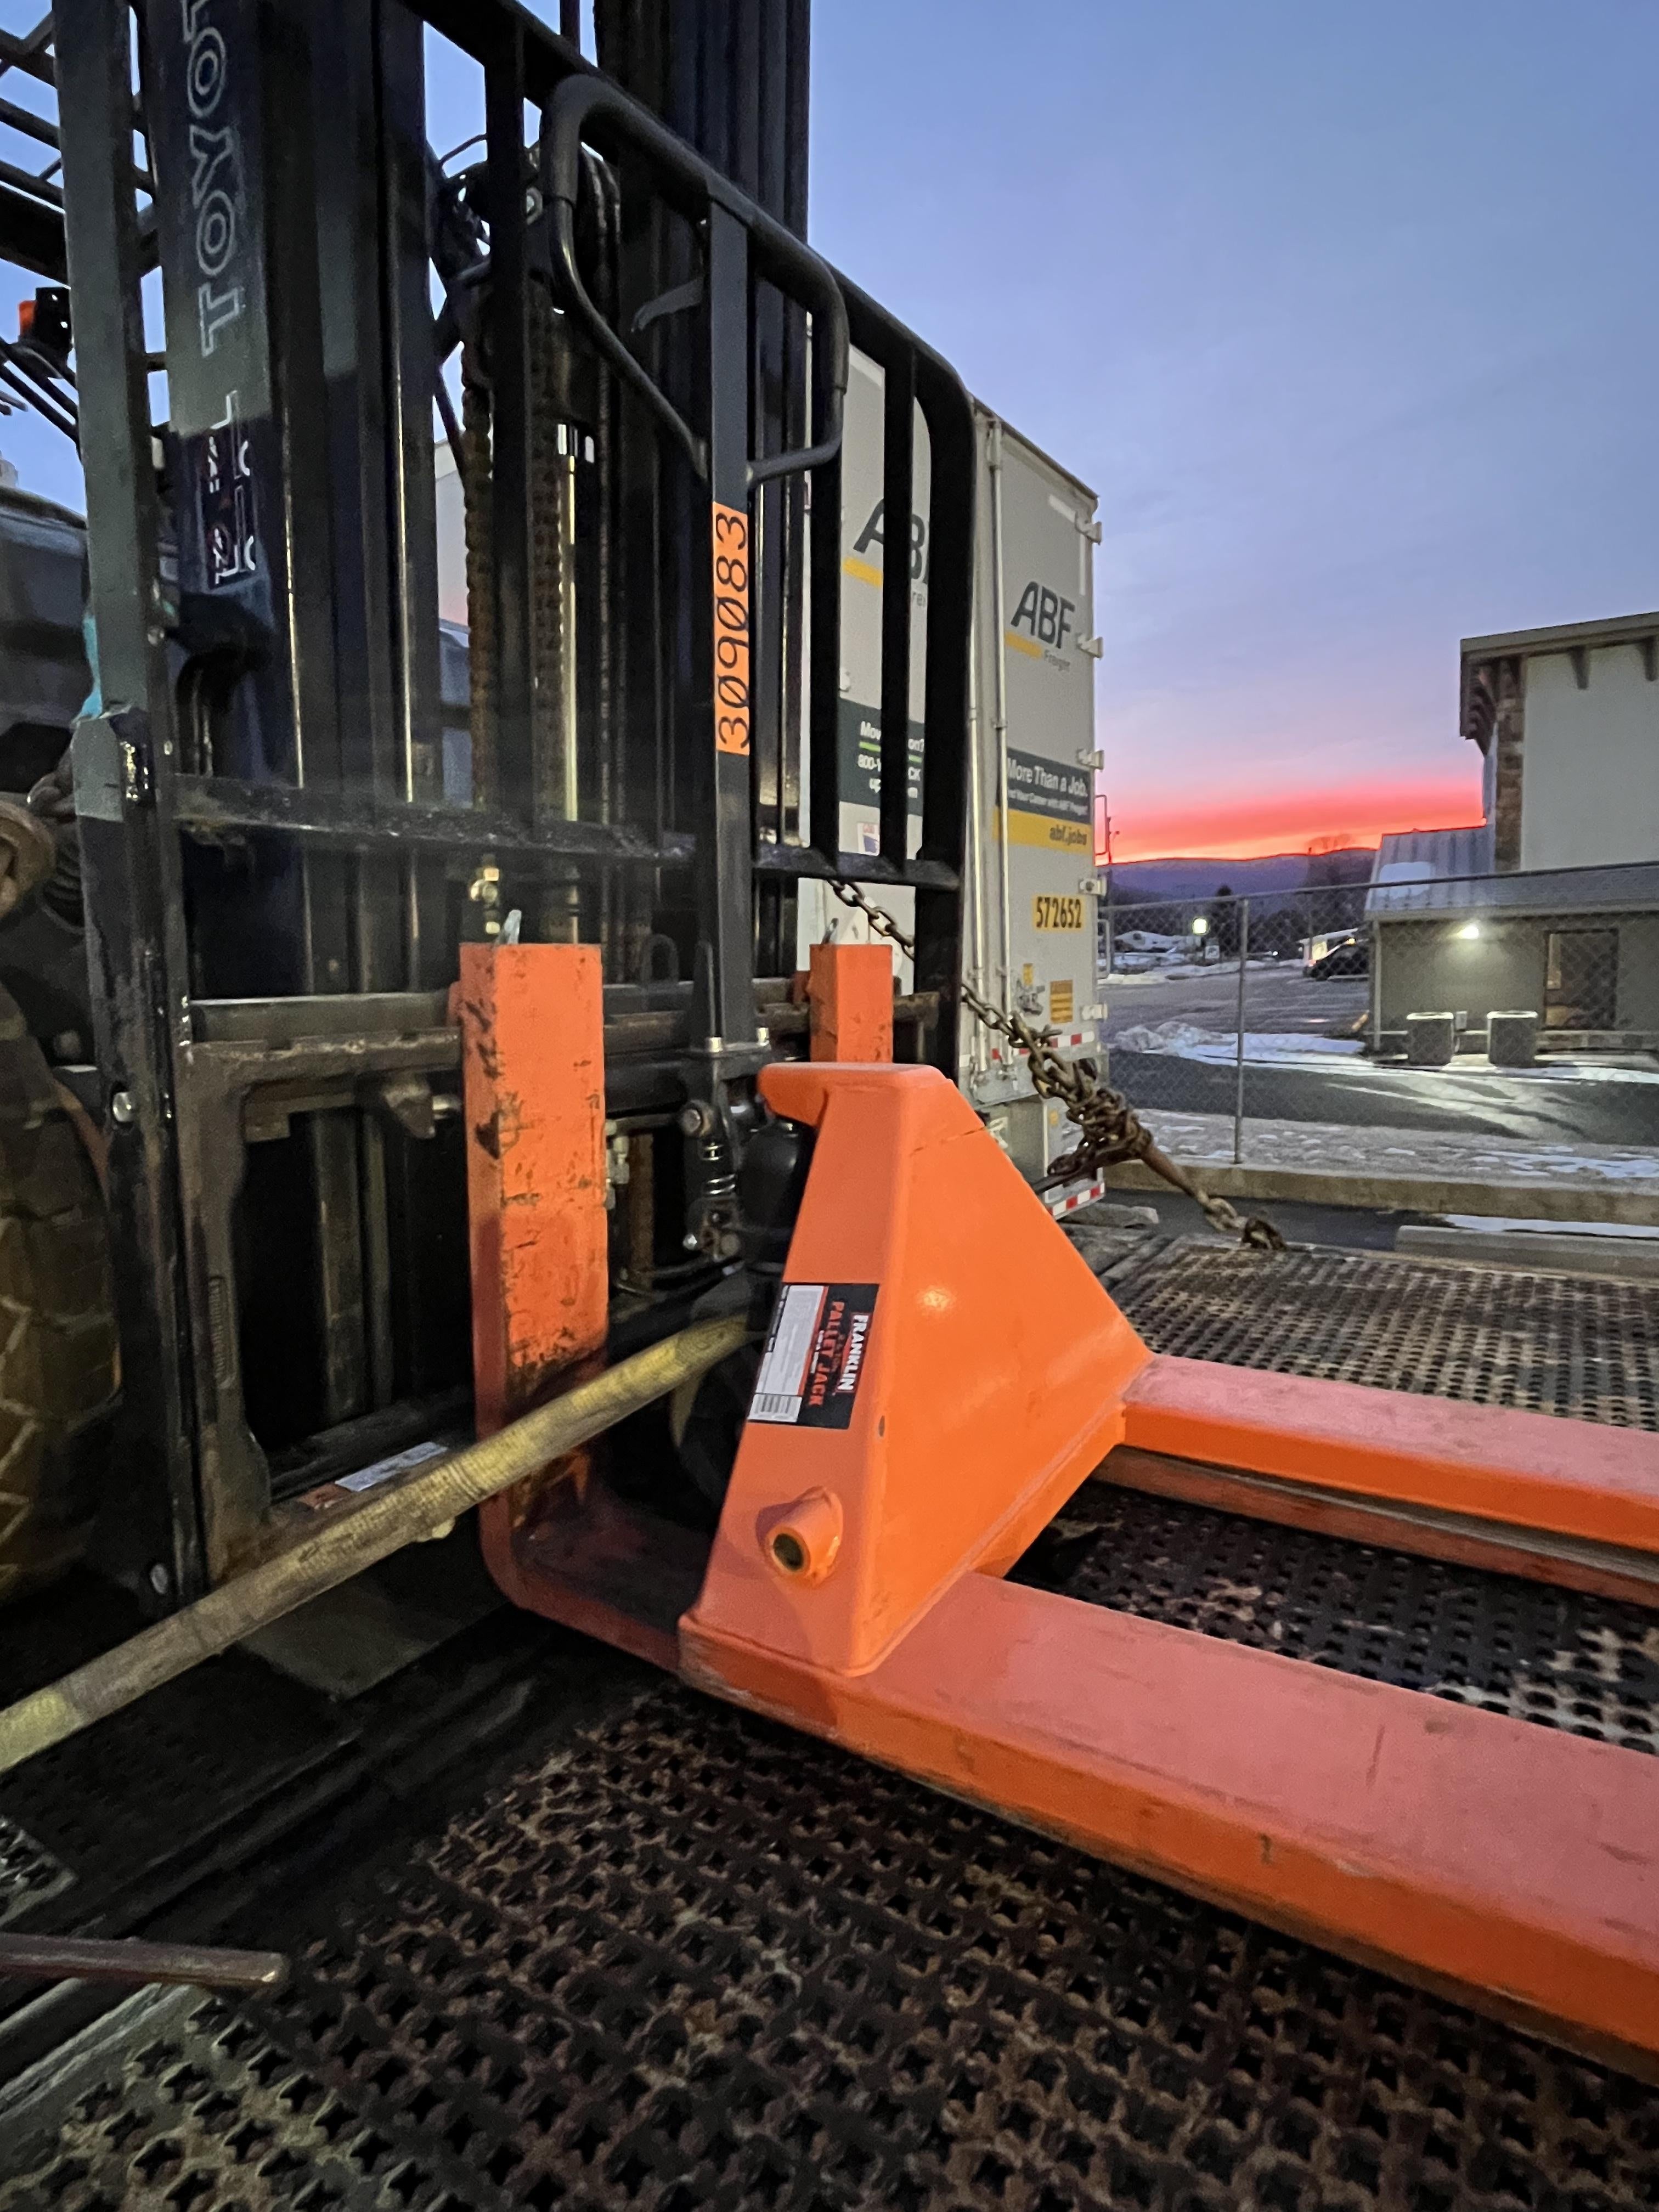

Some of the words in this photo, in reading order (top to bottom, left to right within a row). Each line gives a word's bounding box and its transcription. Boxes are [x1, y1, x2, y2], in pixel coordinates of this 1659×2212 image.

[1011, 581, 1075, 649] ABF
[1007, 758, 1032, 783] More
[1034, 765, 1059, 790] Than
[1060, 777, 1067, 792] a
[1036, 896, 1081, 928] 572652
[820, 1301, 845, 1357] PALLET
[837, 1314, 870, 1391] FRANKLIN
[809, 1363, 831, 1406] JACK
